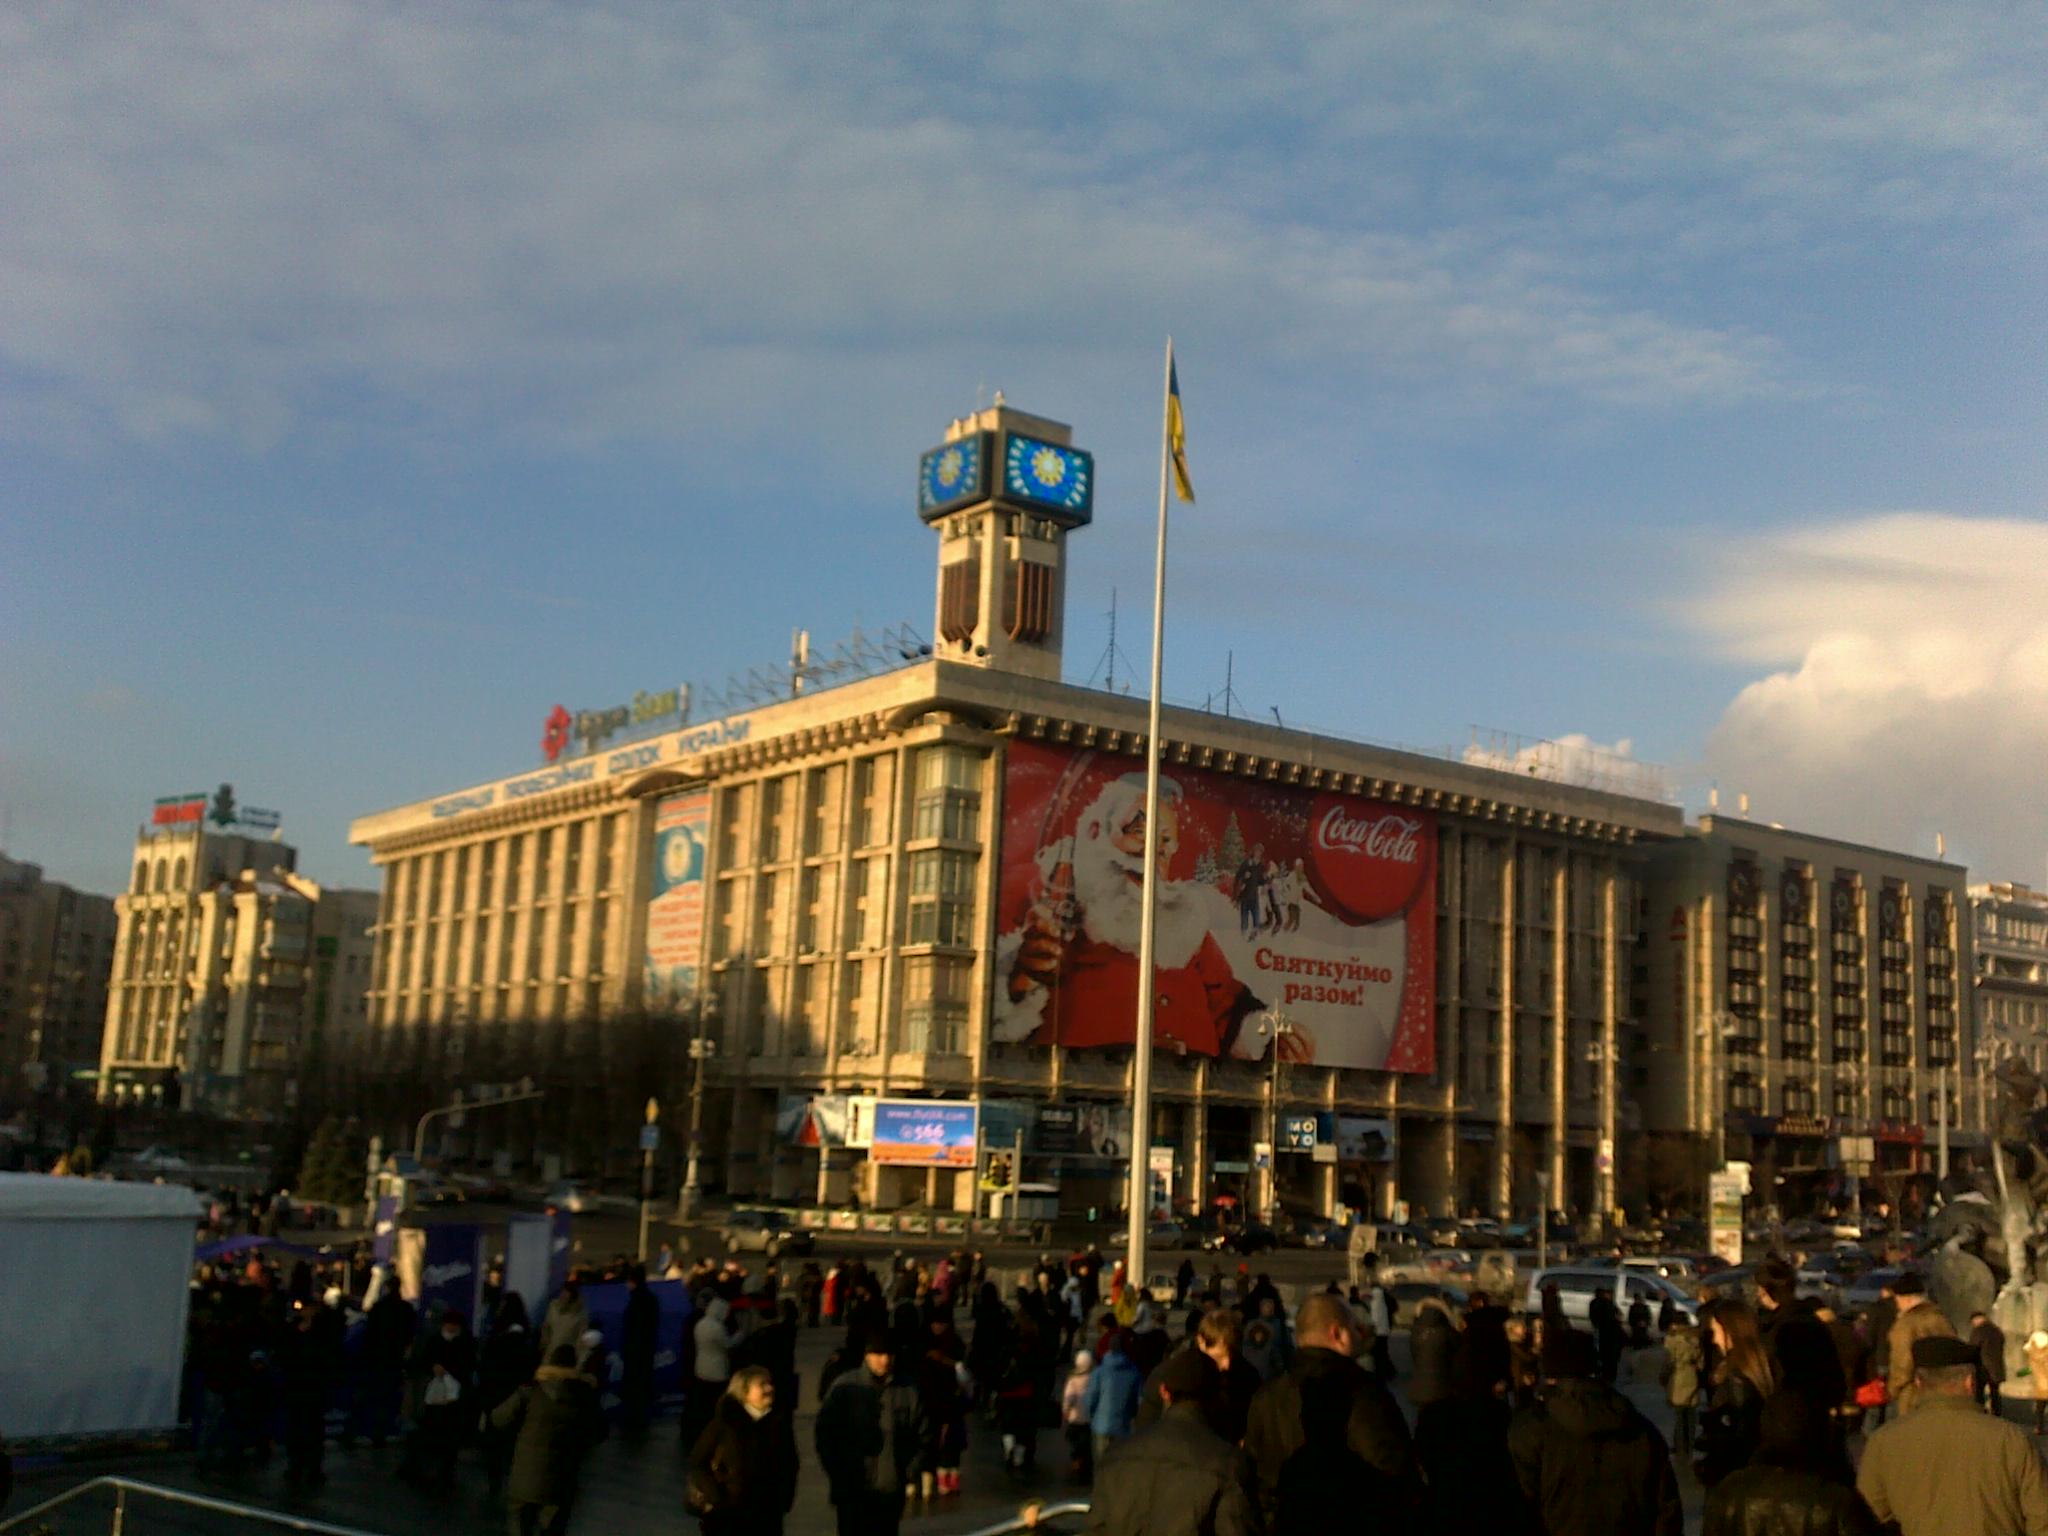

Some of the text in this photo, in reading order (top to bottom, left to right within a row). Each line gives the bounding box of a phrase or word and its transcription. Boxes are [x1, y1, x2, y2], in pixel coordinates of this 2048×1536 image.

[1319, 805, 1421, 862] Coca-Cola
[1255, 948, 1392, 984] Святкуймо
[1285, 984, 1364, 1006] разом!
